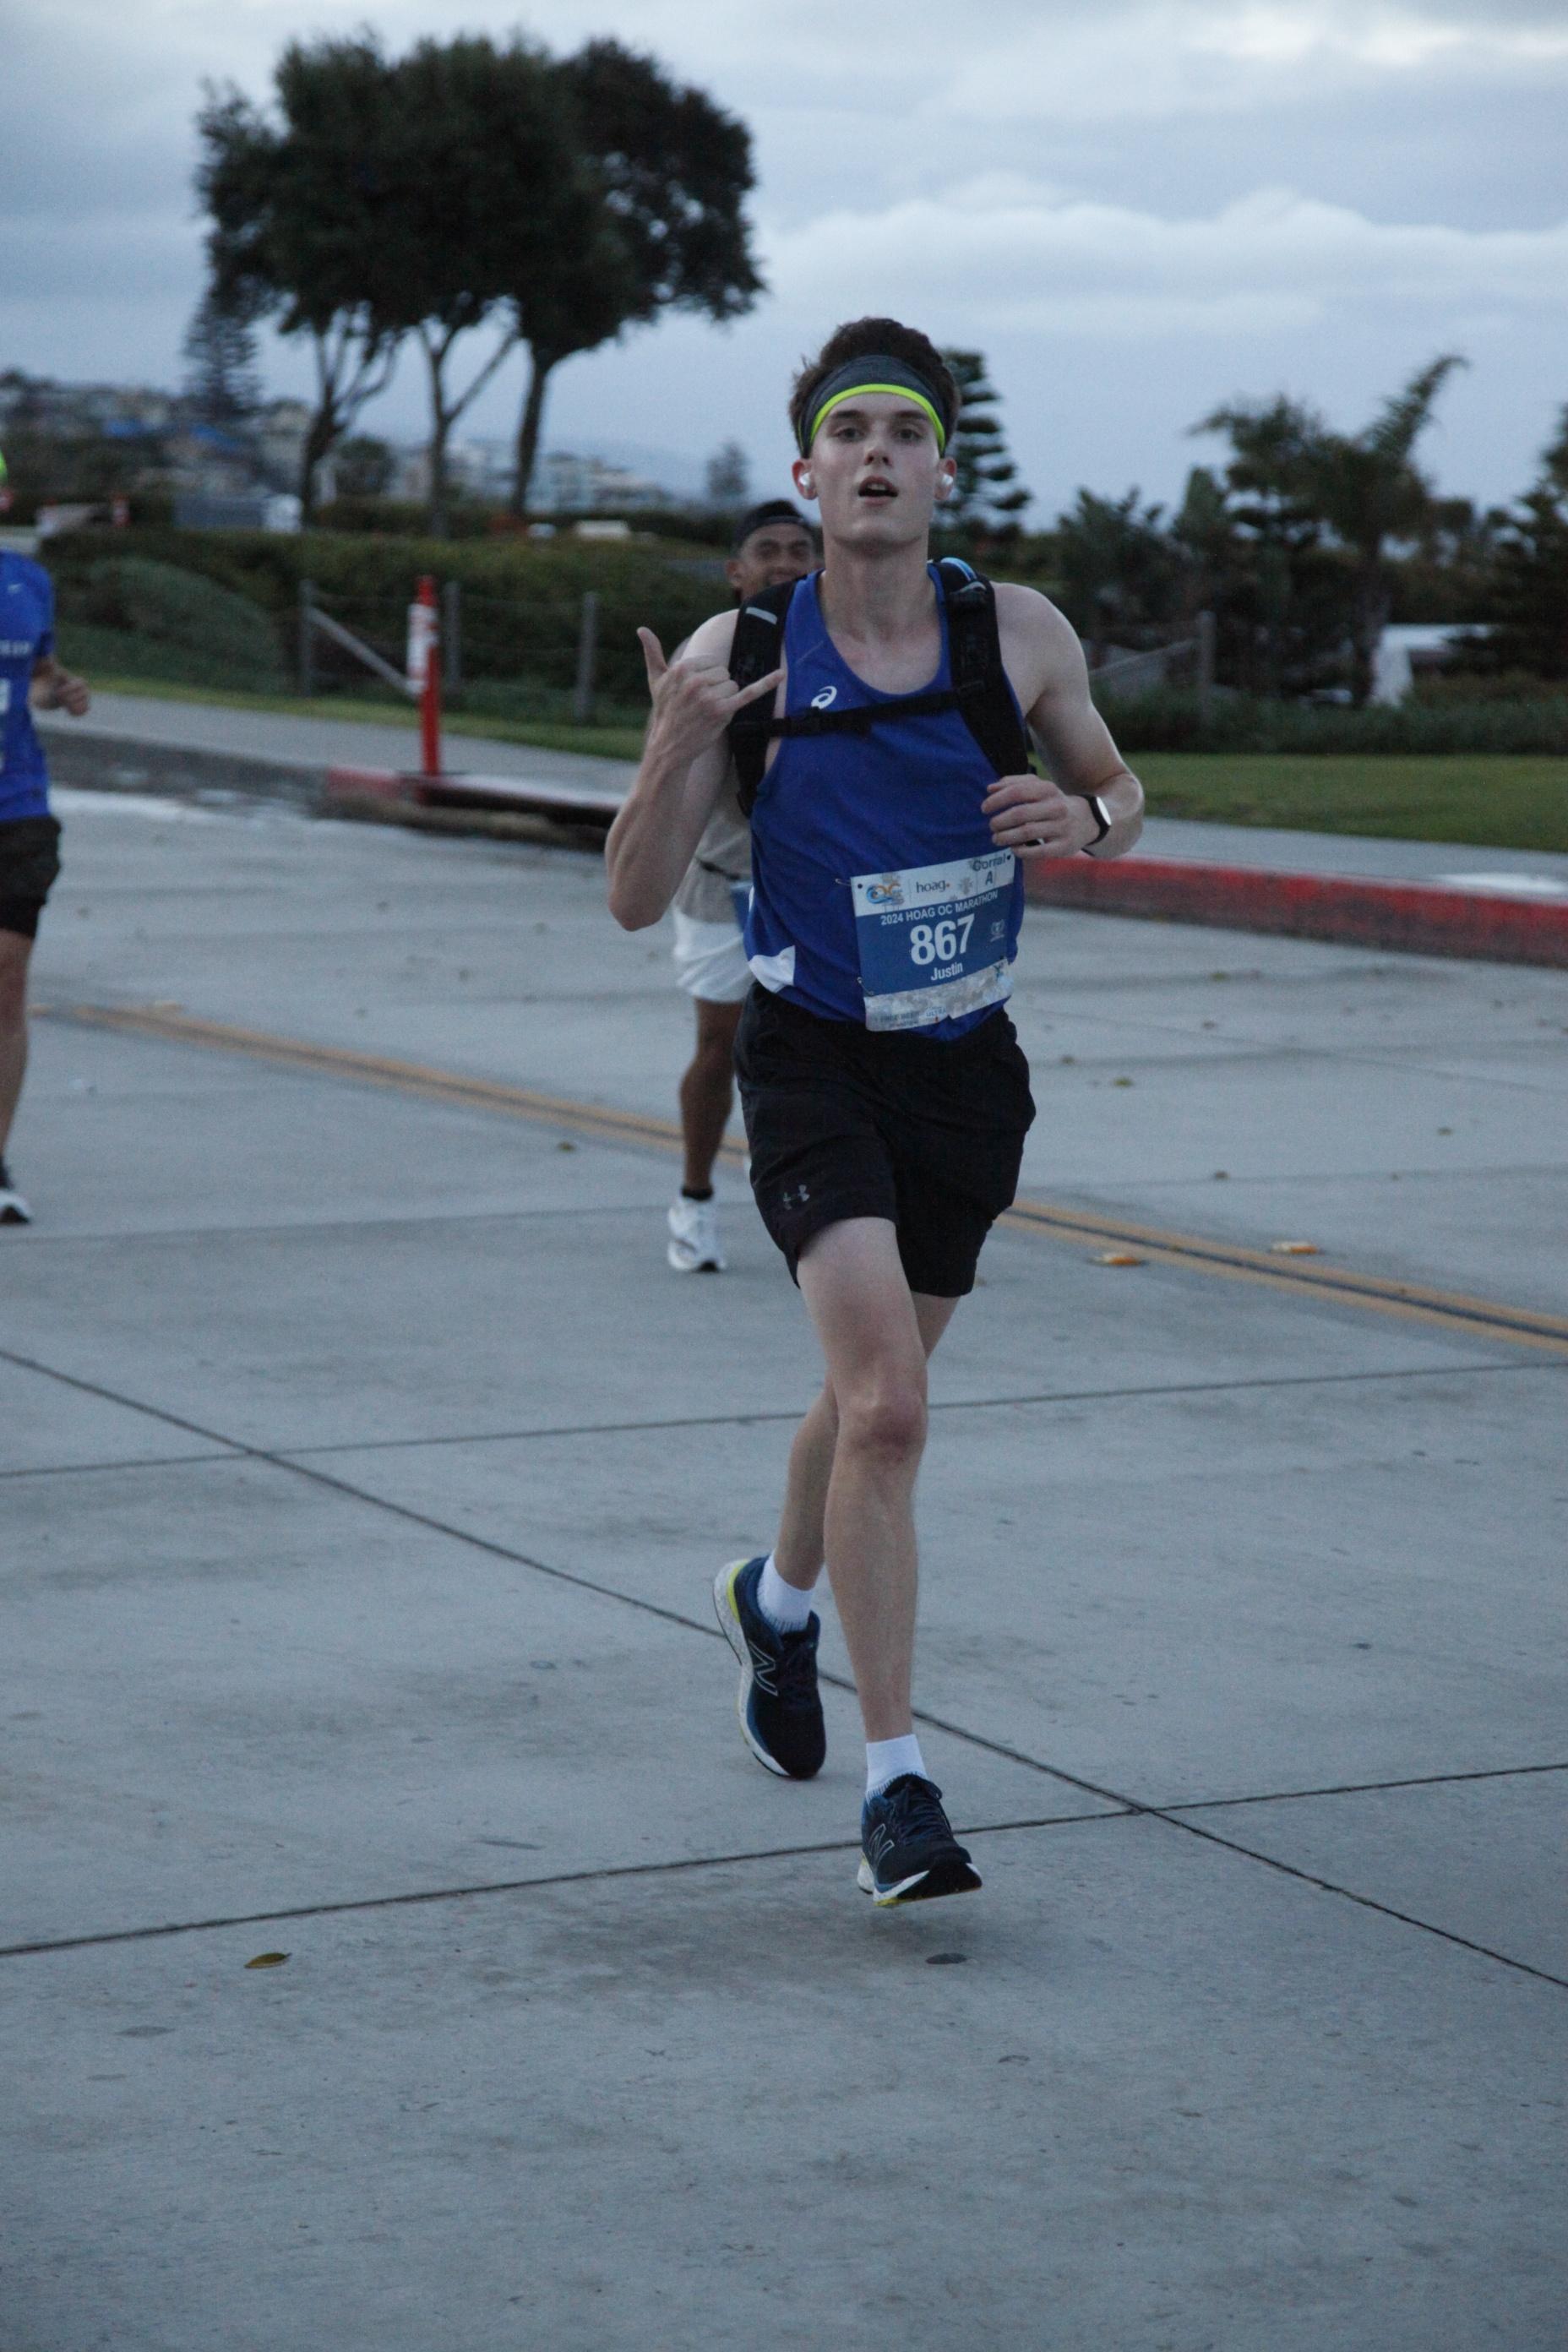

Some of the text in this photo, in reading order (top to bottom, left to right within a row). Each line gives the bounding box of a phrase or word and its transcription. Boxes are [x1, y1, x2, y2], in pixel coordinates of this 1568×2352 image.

[972, 854, 1006, 872] Corral
[985, 871, 994, 885] A
[880, 890, 999, 926] 2024 HOAG OC MARATHON
[909, 913, 975, 966] 867
[930, 961, 963, 982] Justin
